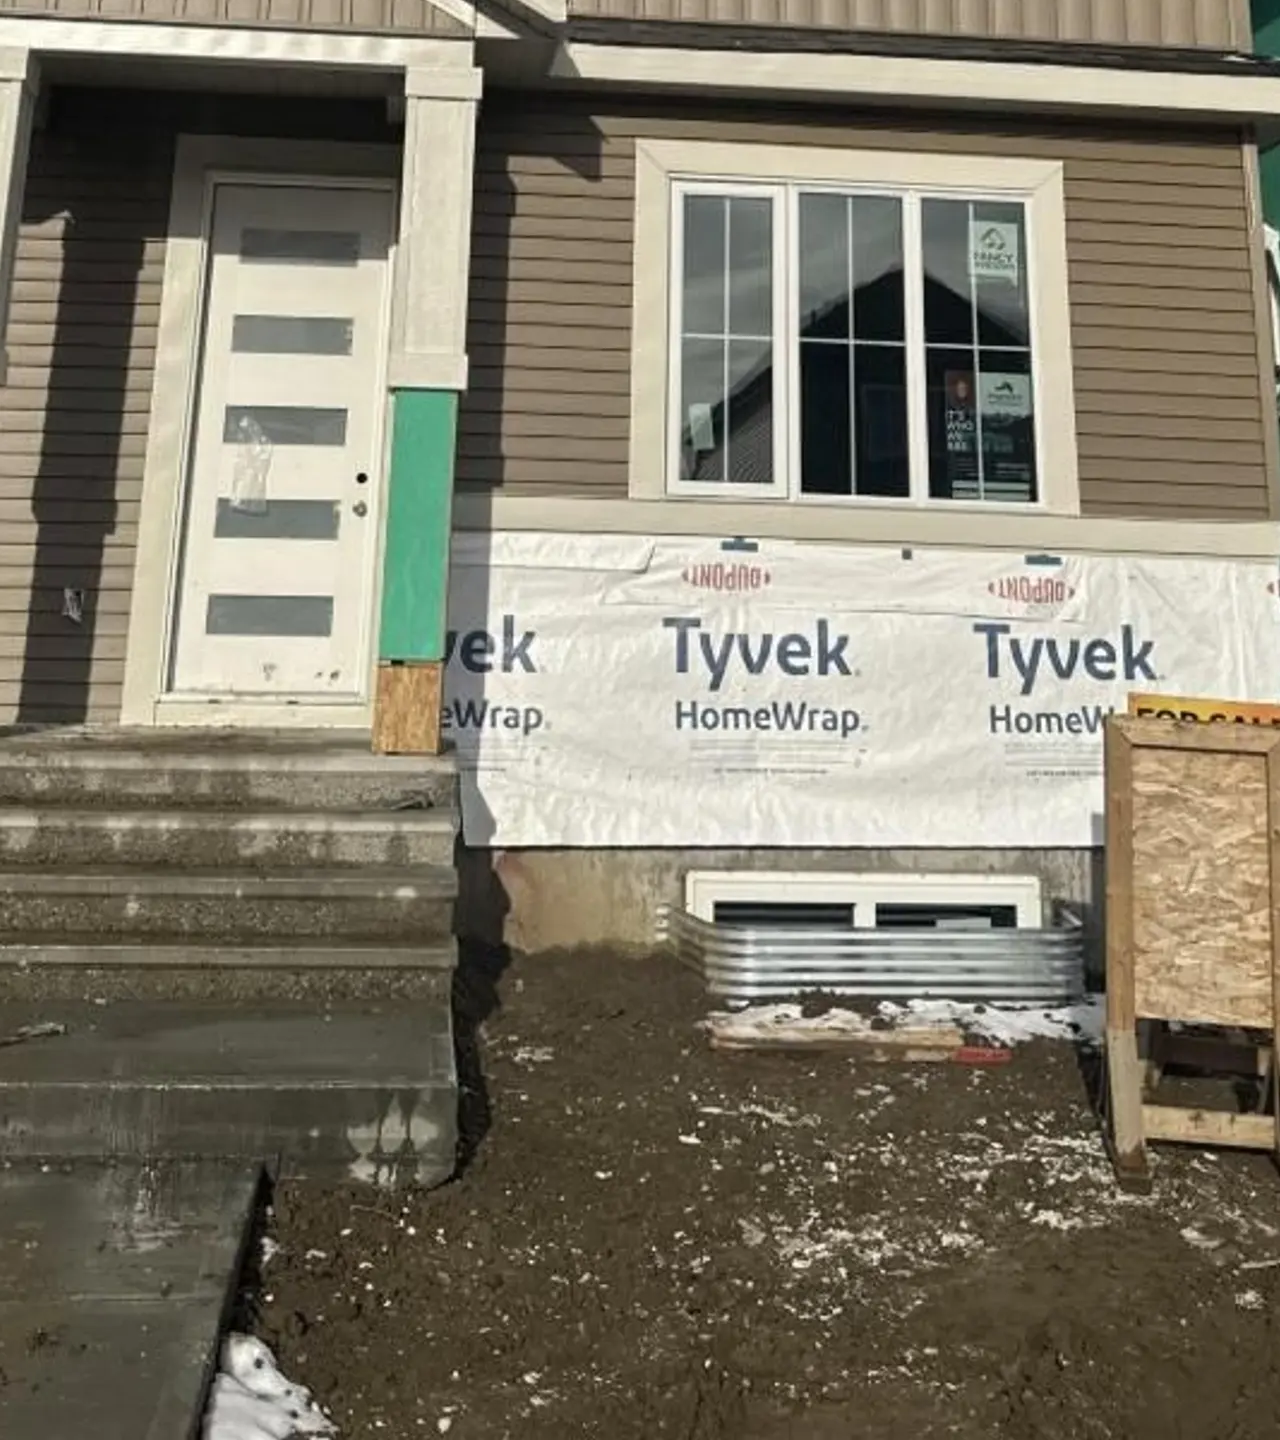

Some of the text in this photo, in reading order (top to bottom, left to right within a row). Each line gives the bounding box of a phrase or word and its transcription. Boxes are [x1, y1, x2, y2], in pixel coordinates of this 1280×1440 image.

[691, 562, 762, 592] DUPONT
[998, 575, 1066, 605] DUPONT
[661, 616, 853, 693] Tyvek
[972, 622, 1158, 697] Tyvek
[675, 699, 860, 739] HomeWrap
